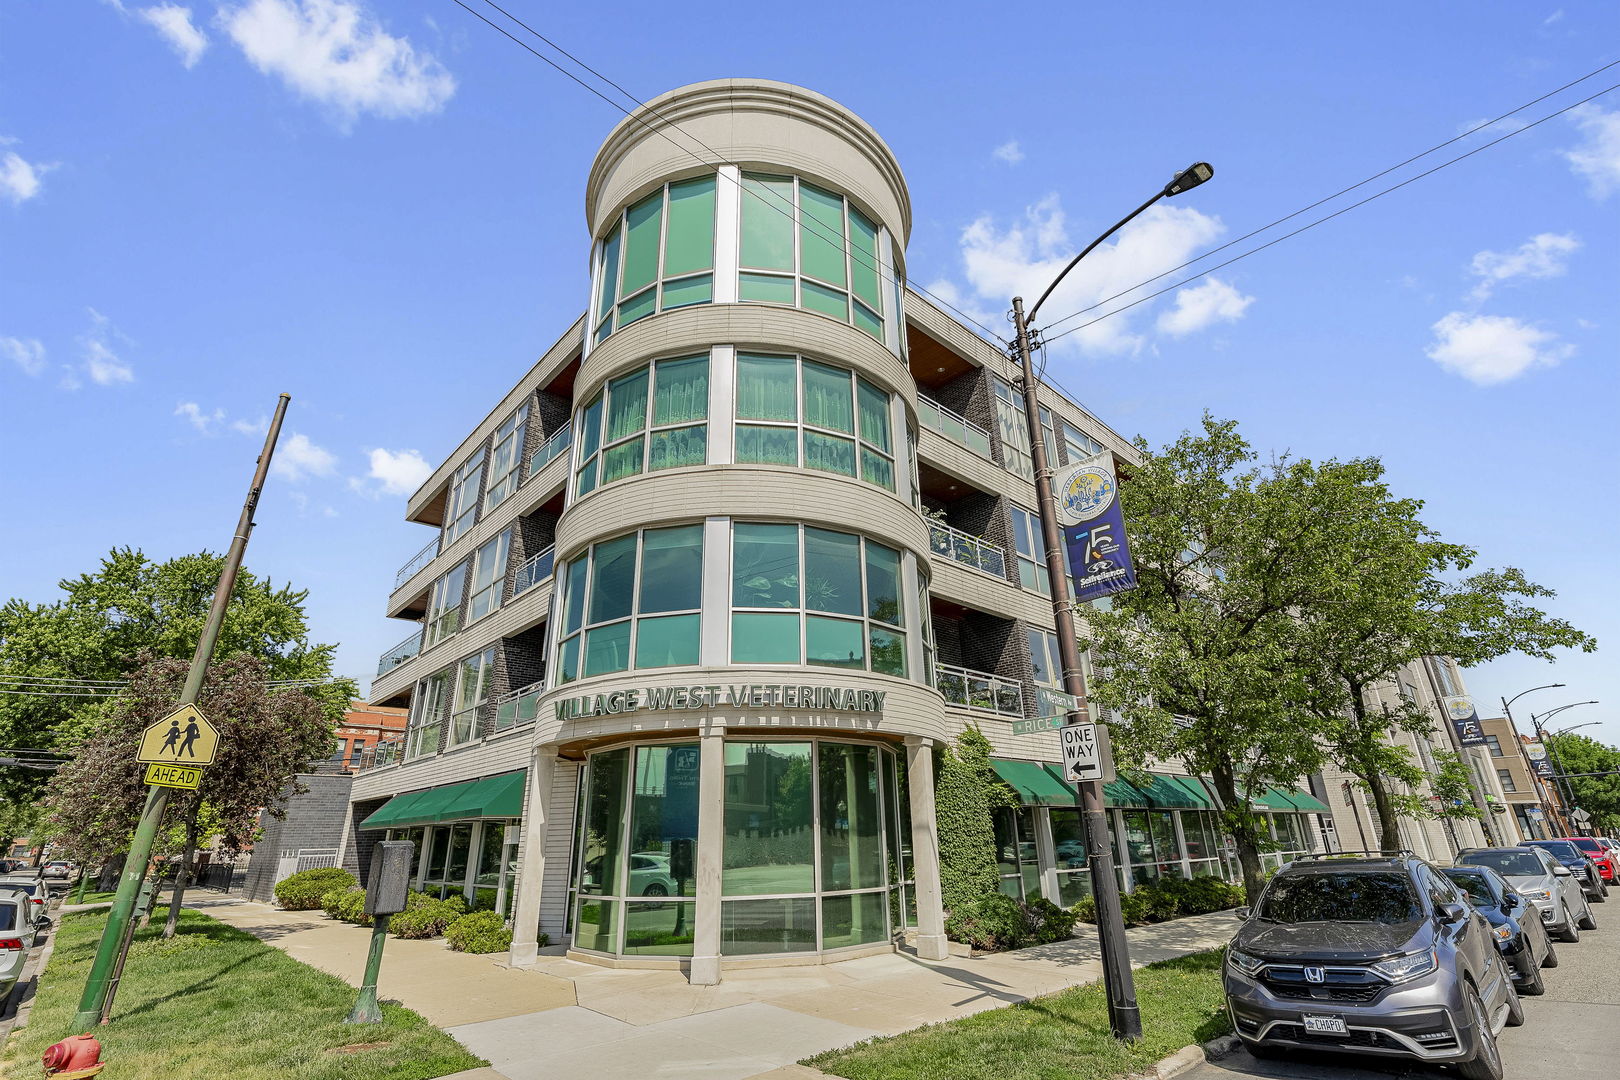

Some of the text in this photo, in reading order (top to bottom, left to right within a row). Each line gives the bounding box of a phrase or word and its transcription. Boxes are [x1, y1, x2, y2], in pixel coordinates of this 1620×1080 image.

[1076, 525, 1112, 564] 75
[554, 685, 887, 721] VILLAGE WEST VETERINARY
[1024, 718, 1053, 732] RICE
[1064, 728, 1093, 744] ONE
[1065, 743, 1094, 759] WAY
[151, 767, 195, 784] AHEAD
